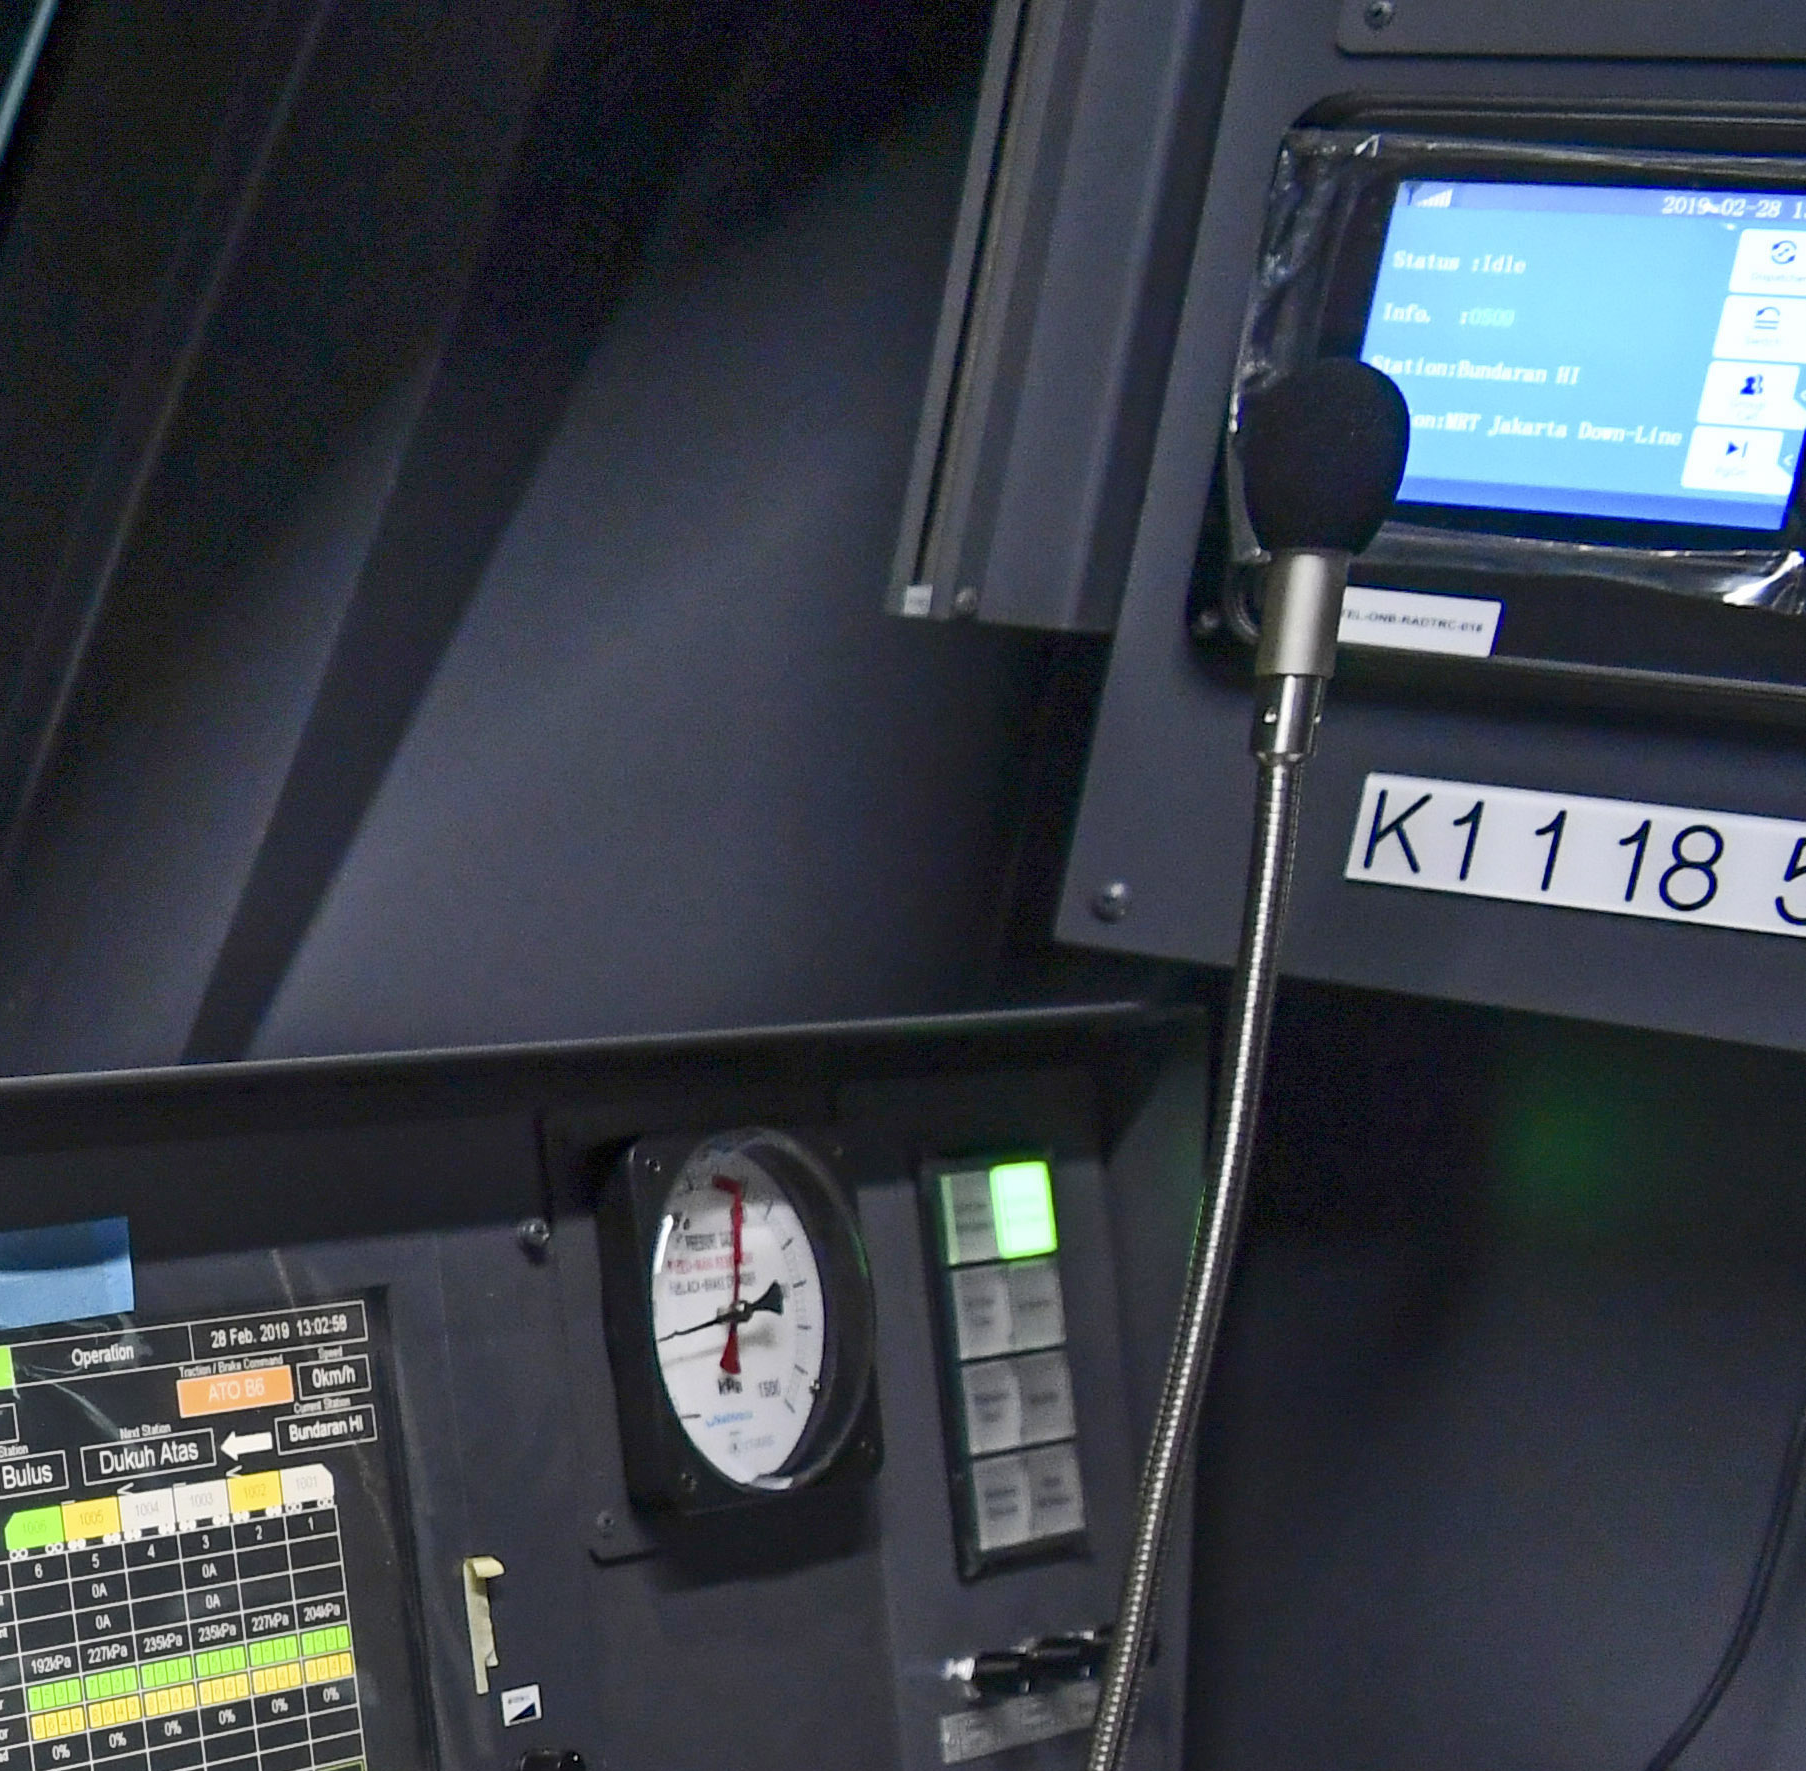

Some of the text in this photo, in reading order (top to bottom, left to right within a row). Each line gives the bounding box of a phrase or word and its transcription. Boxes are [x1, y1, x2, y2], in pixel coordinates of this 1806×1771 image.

[1661, 195, 1782, 218] 2019-02-28
[1392, 250, 1461, 273] Status
[1382, 301, 1432, 325] Info.
[1555, 365, 1582, 386] HI
[1487, 412, 1568, 441] Jakarta
[1577, 420, 1683, 447] Down-Line
[229, 1325, 257, 1346] Feb.
[71, 1341, 134, 1367] Operation
[311, 1363, 355, 1388] 0km/h
[207, 1377, 265, 1403] ATO B6
[288, 1414, 363, 1442] Bundaran HI
[98, 1437, 199, 1474] Dukuh Atas
[1, 1459, 53, 1489] Bulus
[254, 1525, 263, 1540] 2
[307, 1516, 314, 1531] 1
[201, 1534, 210, 1549] 3
[146, 1543, 155, 1559] 4
[91, 1553, 100, 1568] 5
[33, 1563, 43, 1579] 6
[201, 1562, 217, 1578] 0A
[91, 1582, 107, 1598] 0A
[204, 1592, 221, 1609] 0A
[94, 1612, 111, 1630] 0A
[143, 1631, 183, 1653] 235kPa
[86, 1641, 128, 1664] 227kPa
[30, 1652, 71, 1675] 192kPa
[322, 1686, 340, 1703] 0%
[271, 1697, 288, 1714] 0%
[218, 1708, 236, 1726] 0%
[163, 1719, 182, 1737] 0%
[108, 1731, 127, 1749] 0%
[51, 1743, 71, 1761] 0%
